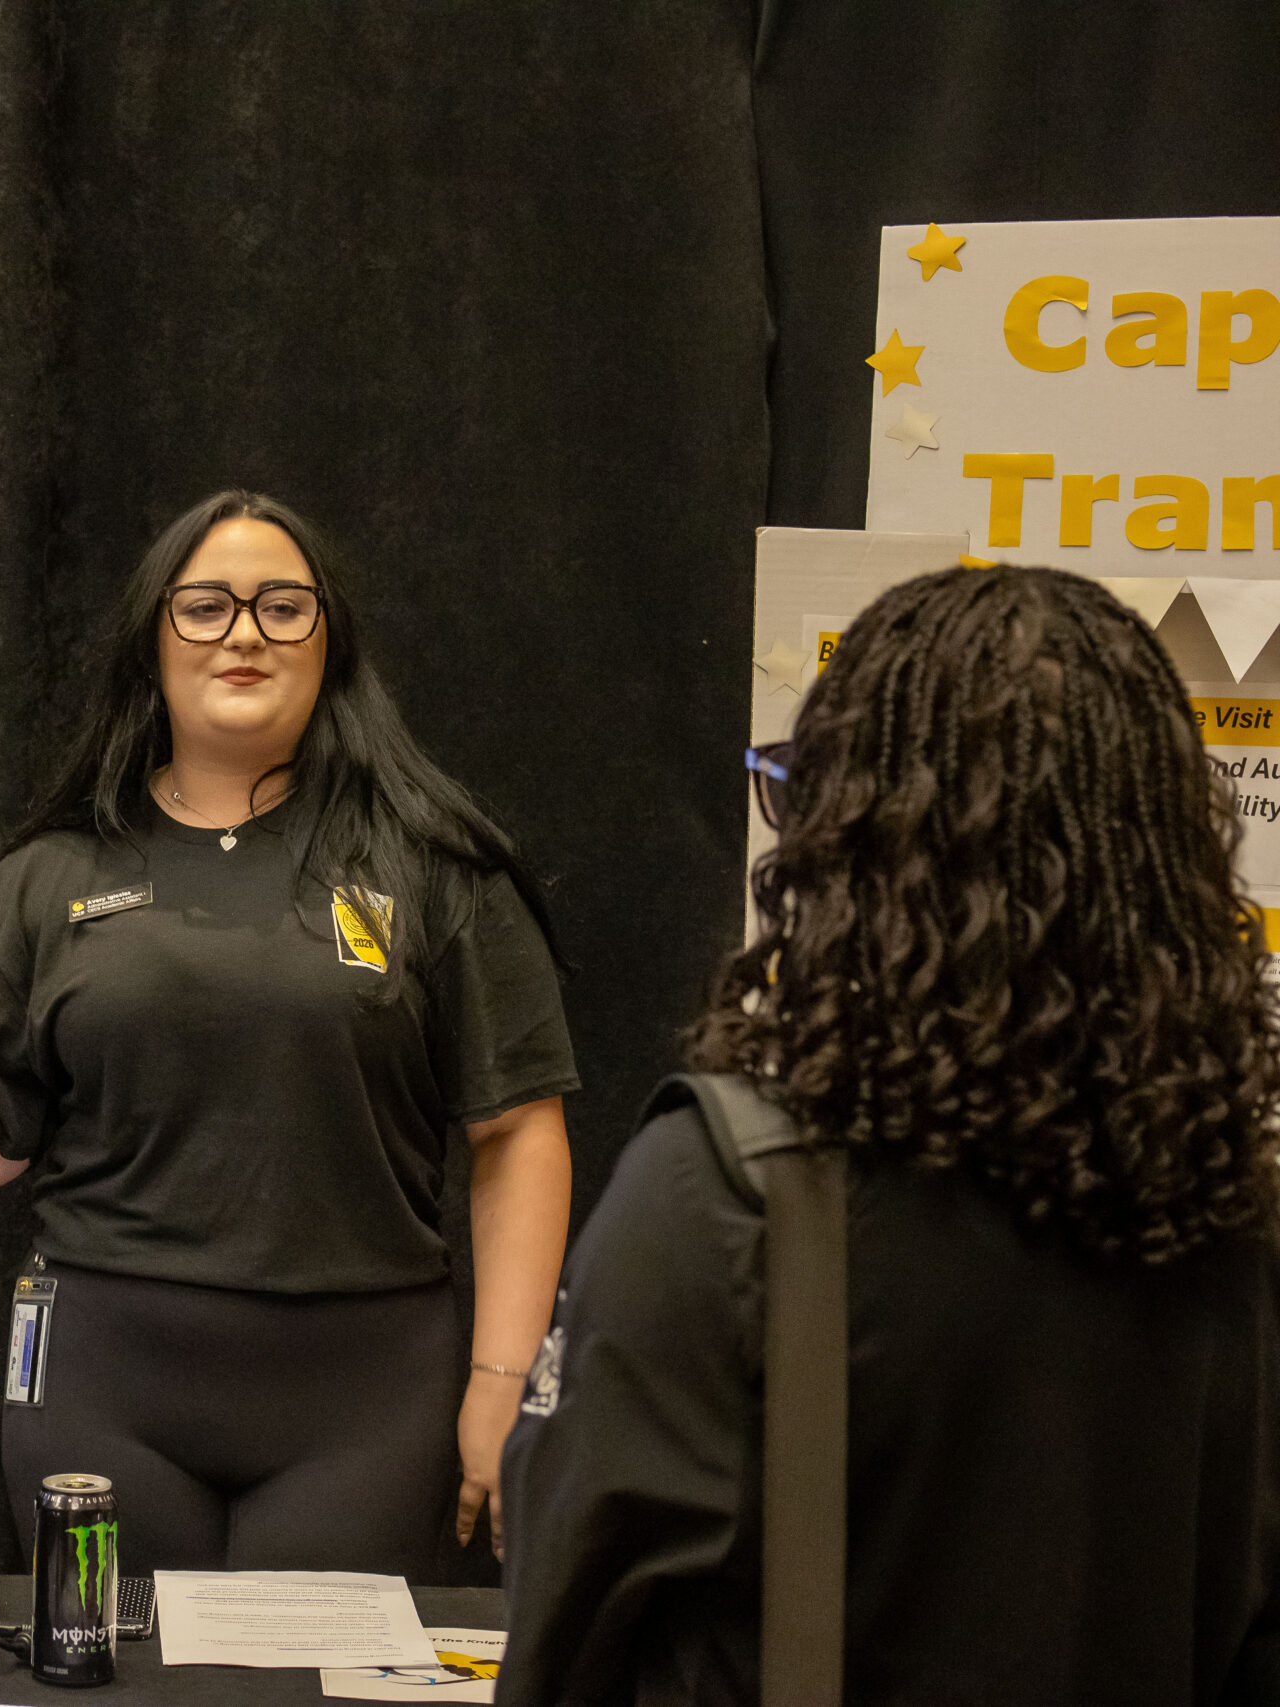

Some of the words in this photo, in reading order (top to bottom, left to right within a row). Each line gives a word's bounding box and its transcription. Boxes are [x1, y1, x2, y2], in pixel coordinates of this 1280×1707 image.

[1003, 275, 1280, 391] Cap
[962, 453, 1280, 551] Tran
[1216, 706, 1274, 729] Visit
[353, 937, 374, 949] 2026
